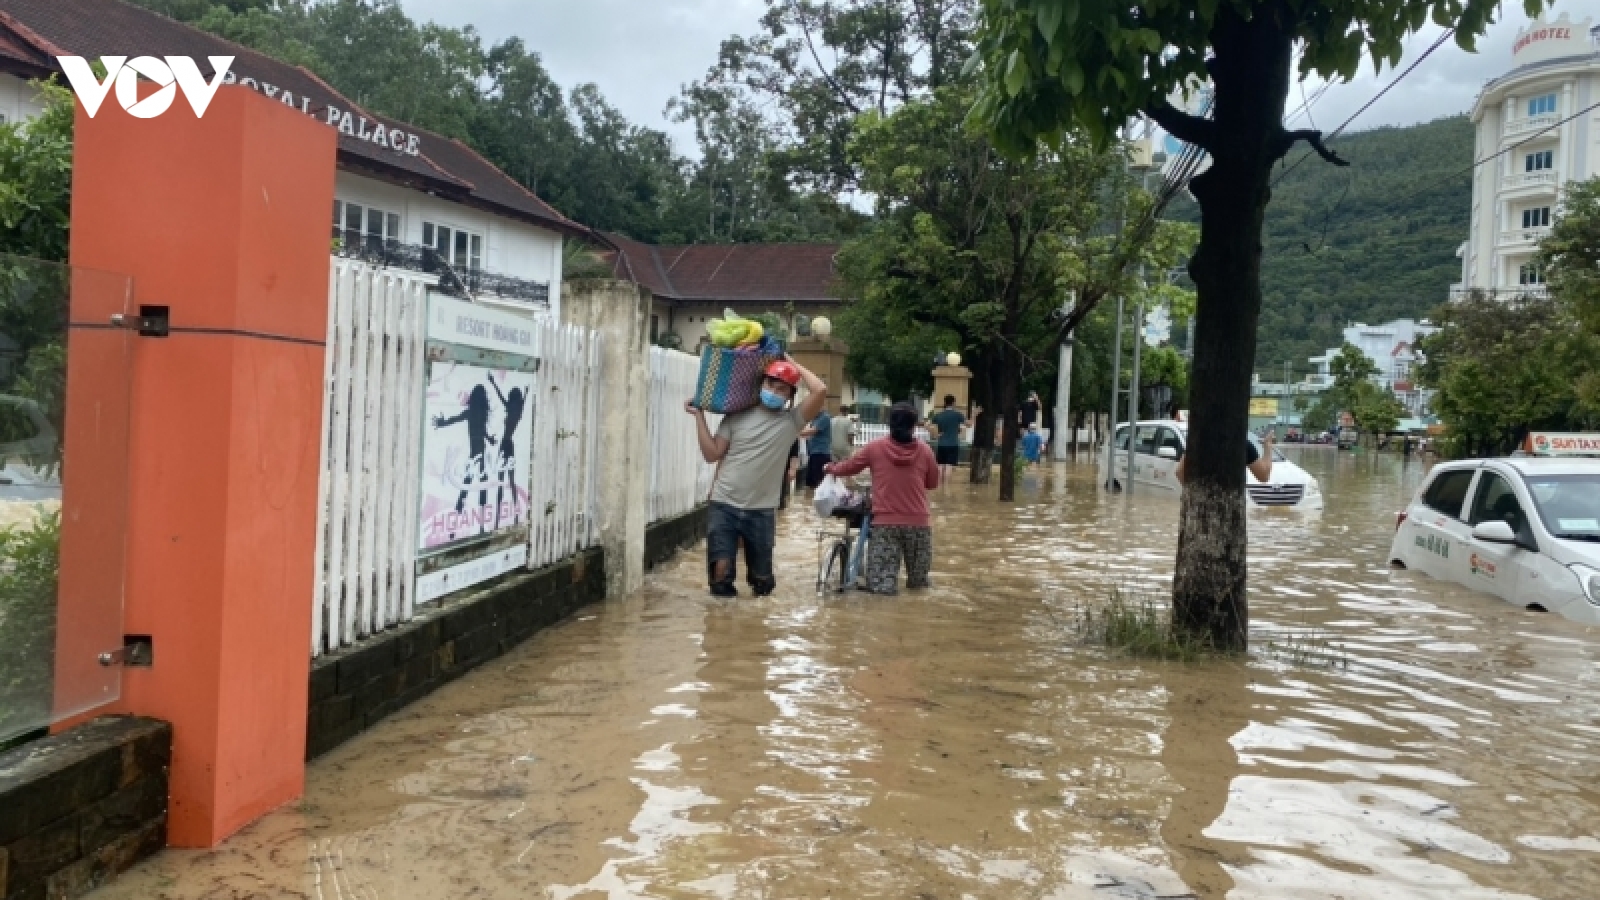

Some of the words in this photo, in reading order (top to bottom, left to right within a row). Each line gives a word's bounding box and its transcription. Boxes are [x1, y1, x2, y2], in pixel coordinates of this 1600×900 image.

[1532, 27, 1571, 42] HOTEL
[325, 103, 421, 157] PALACE
[455, 314, 490, 339] RESORT
